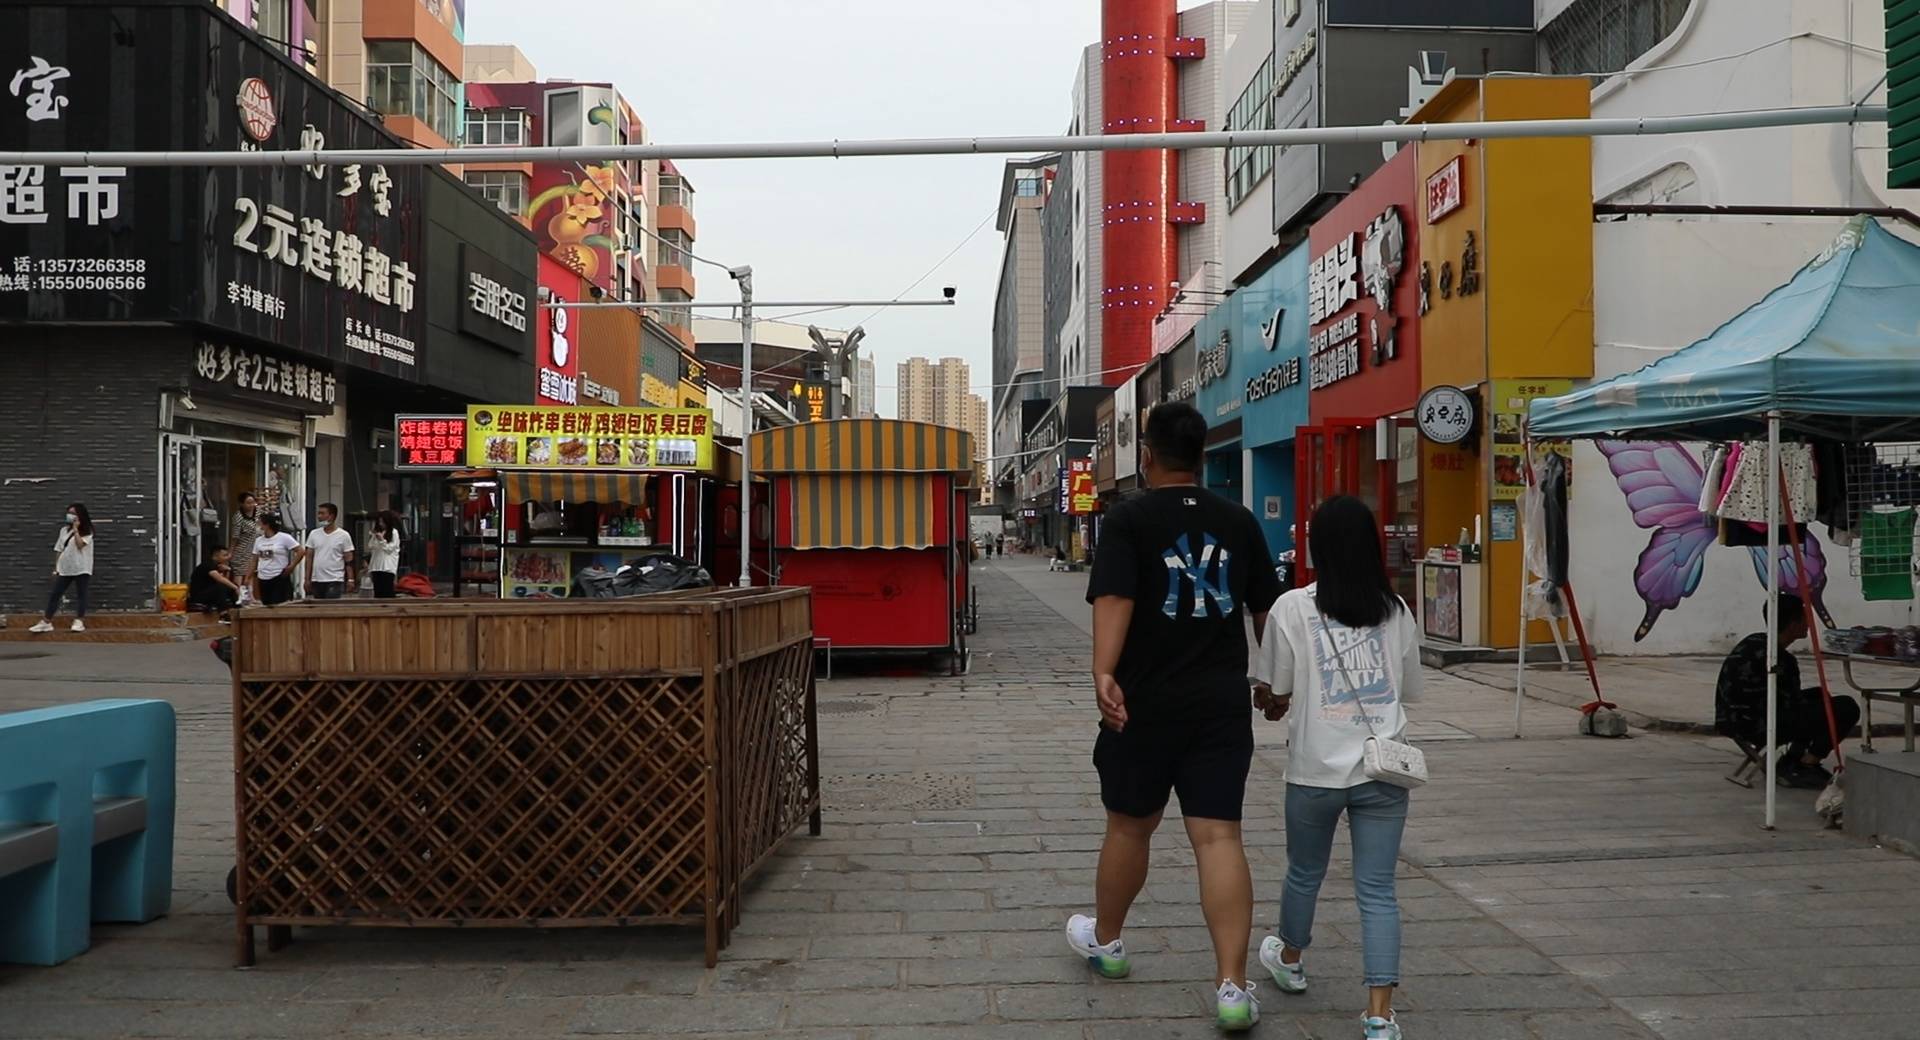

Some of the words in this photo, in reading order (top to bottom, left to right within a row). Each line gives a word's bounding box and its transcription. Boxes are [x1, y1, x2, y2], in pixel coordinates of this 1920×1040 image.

[9, 56, 71, 121] 宝
[0, 165, 127, 226] 超市
[233, 197, 417, 313] 2元连锁超市
[227, 281, 285, 320] 李书建商行
[197, 341, 337, 405] 好多宝2元连锁超市
[540, 367, 578, 405] 蜜雪冰城
[400, 420, 464, 435] 炸串卷饼
[400, 435, 464, 450] 鸡翅包饭
[497, 411, 592, 435] 绝味炸串卷饼
[595, 412, 657, 436] 鸡翅包饭
[660, 413, 707, 436] 臭豆腐
[409, 450, 456, 465] 臭豆腐
[1161, 531, 1235, 620] NY
[1322, 638, 1384, 671] MOVING
